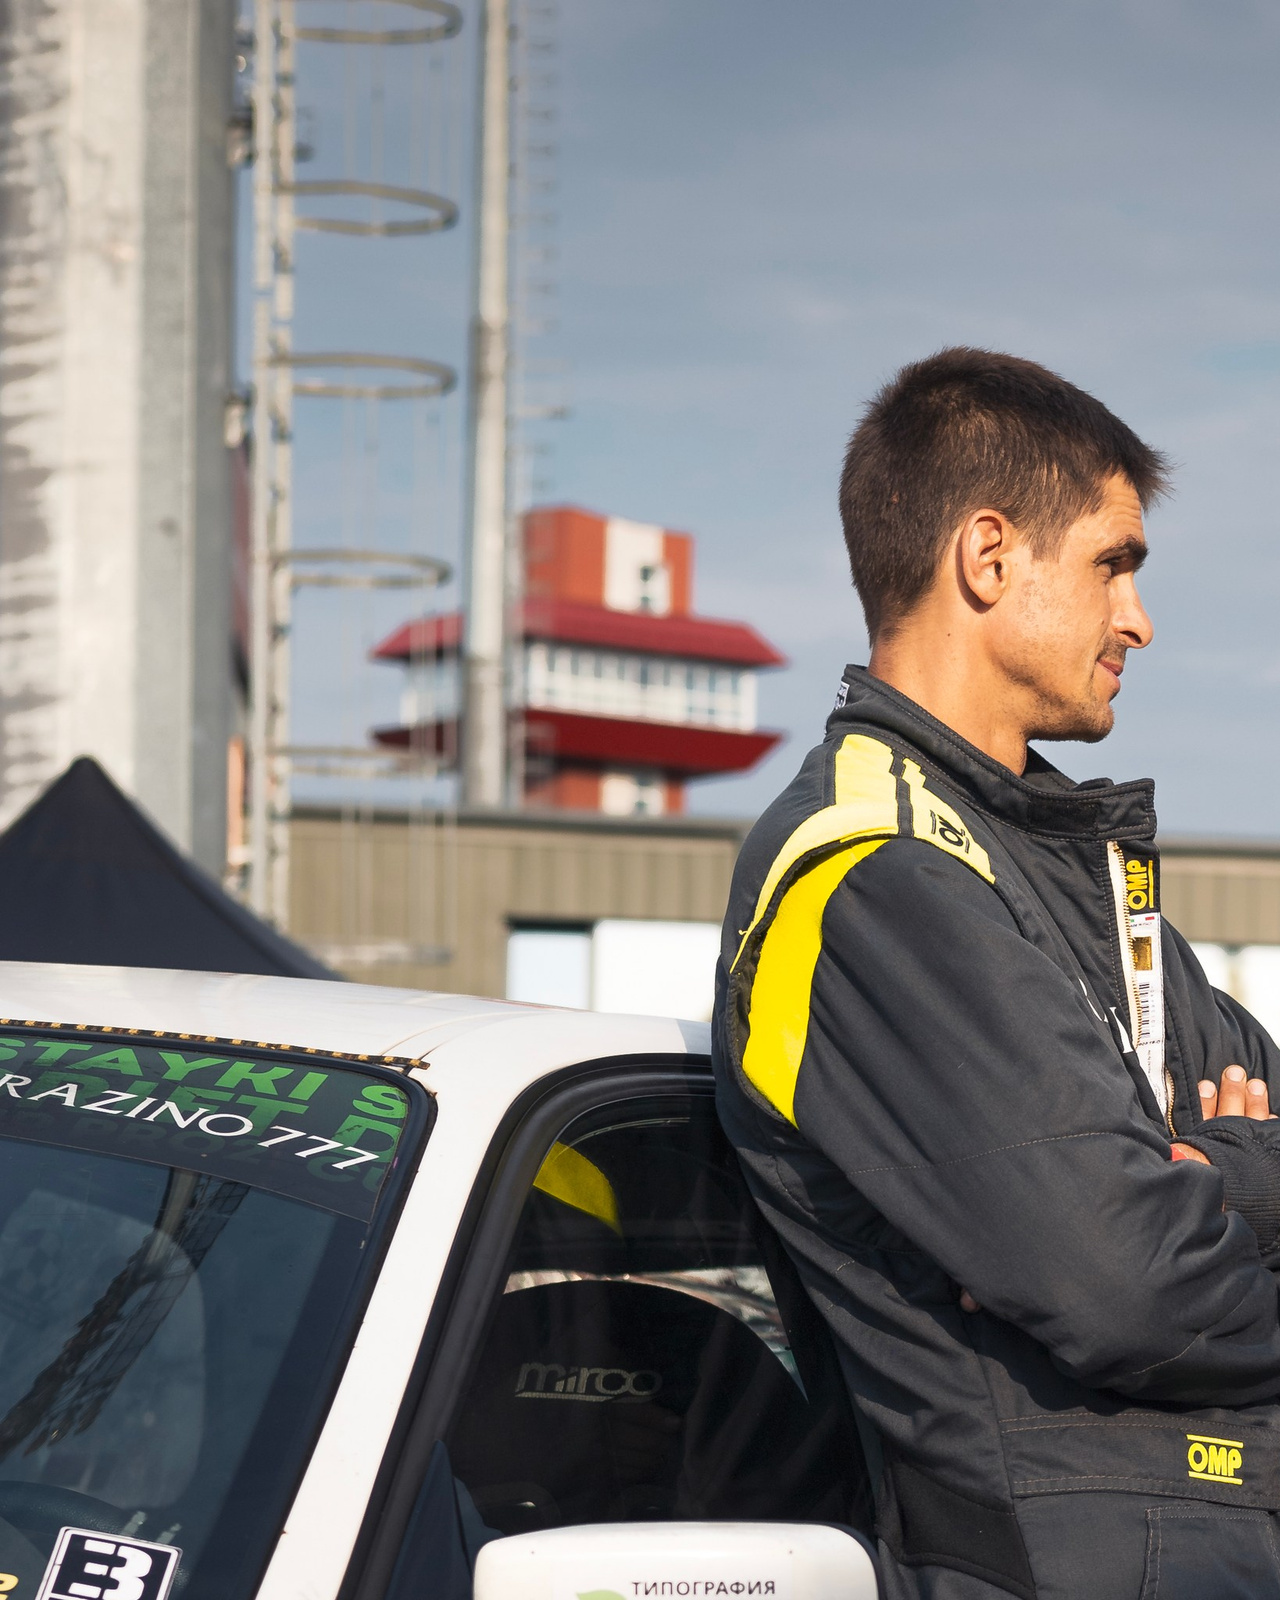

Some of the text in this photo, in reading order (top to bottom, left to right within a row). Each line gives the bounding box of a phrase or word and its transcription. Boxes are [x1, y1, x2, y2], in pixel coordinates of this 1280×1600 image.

[1126, 859, 1148, 910] OMP
[1187, 1442, 1243, 1477] OMP
[632, 1580, 776, 1597] ТИПОГРАФИЯ
